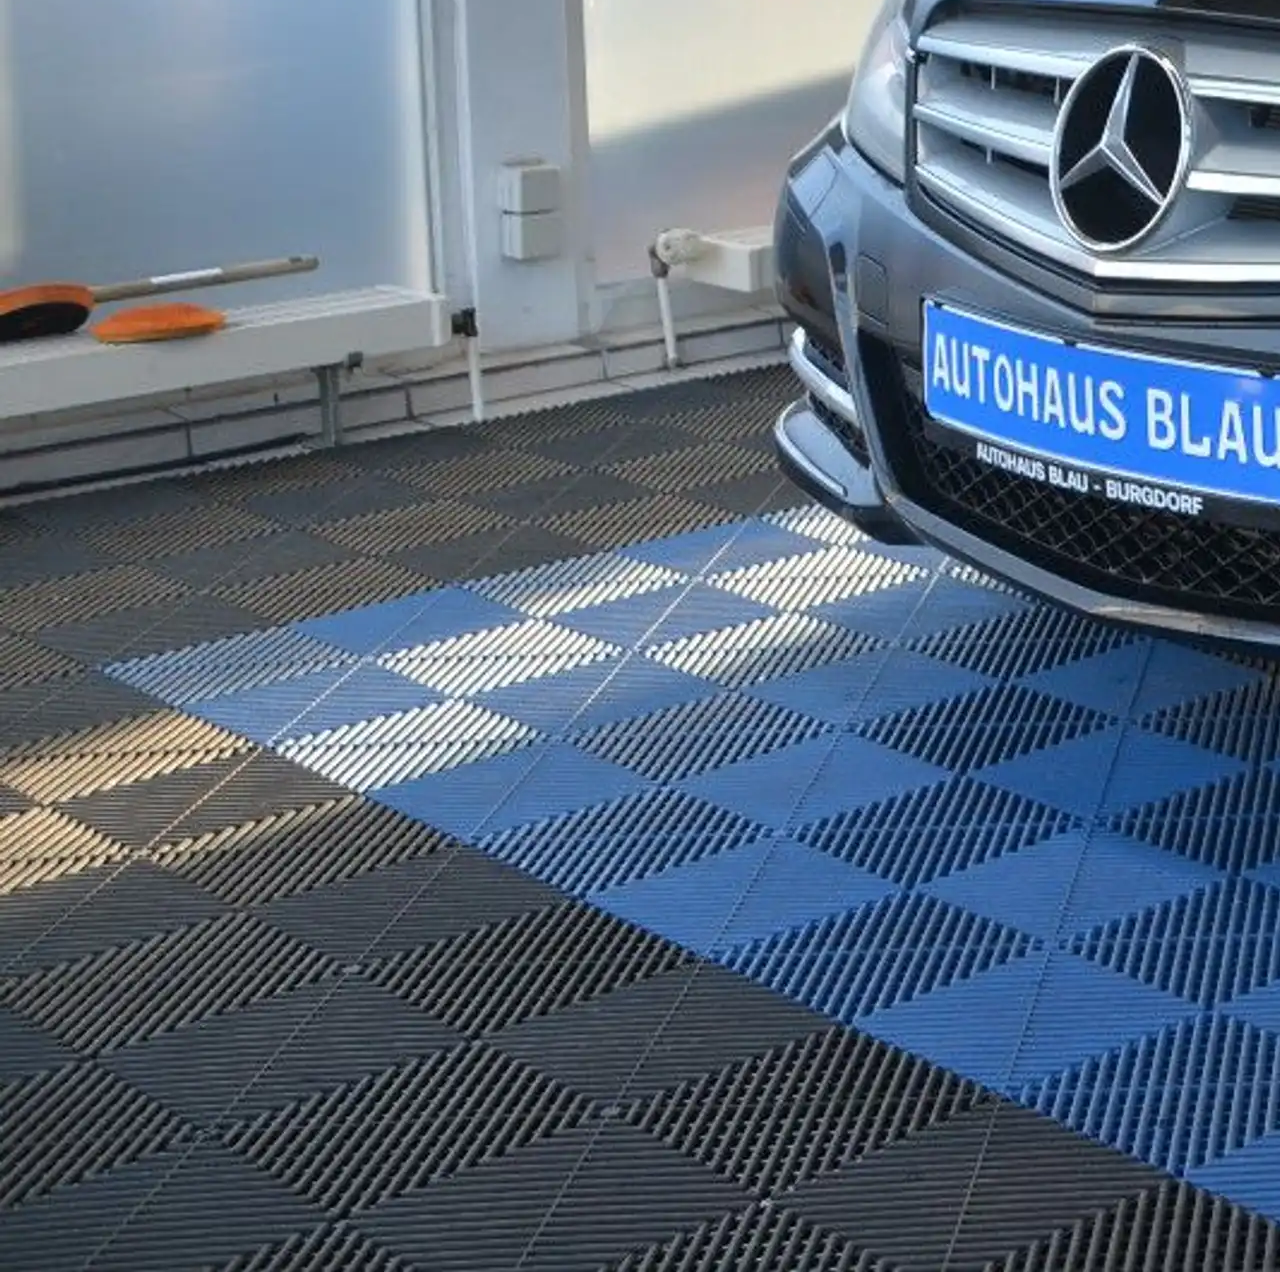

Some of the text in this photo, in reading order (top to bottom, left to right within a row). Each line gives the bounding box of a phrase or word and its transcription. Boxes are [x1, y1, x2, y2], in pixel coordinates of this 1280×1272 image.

[932, 333, 1127, 441] AUTOHAUS
[976, 442, 1045, 480] AUTOHAUS
[1048, 465, 1088, 492] BLAU
[1106, 479, 1203, 516] BURGDORF
